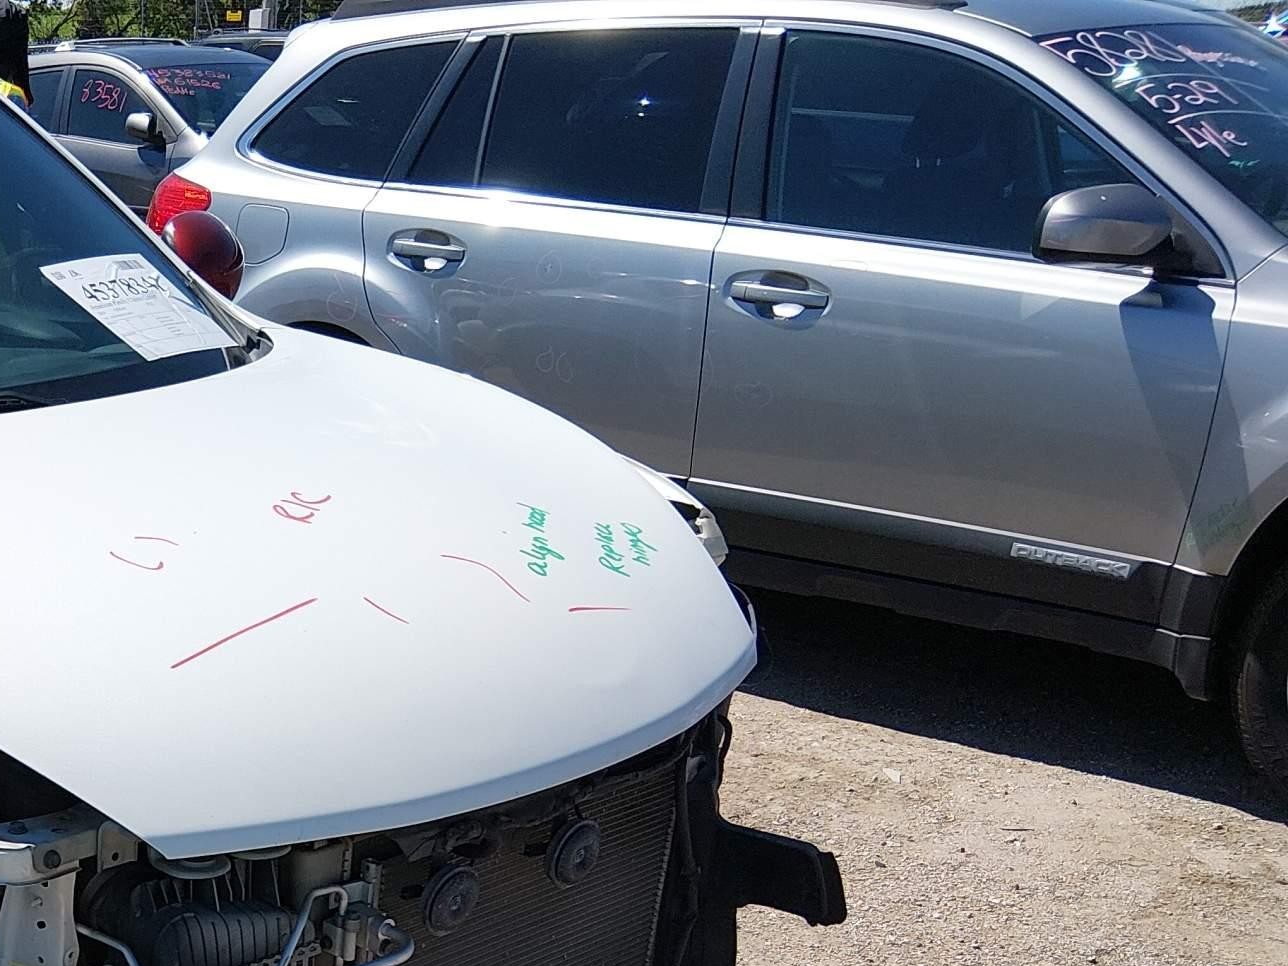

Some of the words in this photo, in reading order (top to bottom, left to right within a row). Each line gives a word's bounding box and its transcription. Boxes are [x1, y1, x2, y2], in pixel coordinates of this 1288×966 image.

[80, 79, 128, 113] 83581
[1135, 80, 1239, 114] 5-29
[1175, 120, 1248, 158] Lyle
[1010, 541, 1131, 579] OUTBACK
